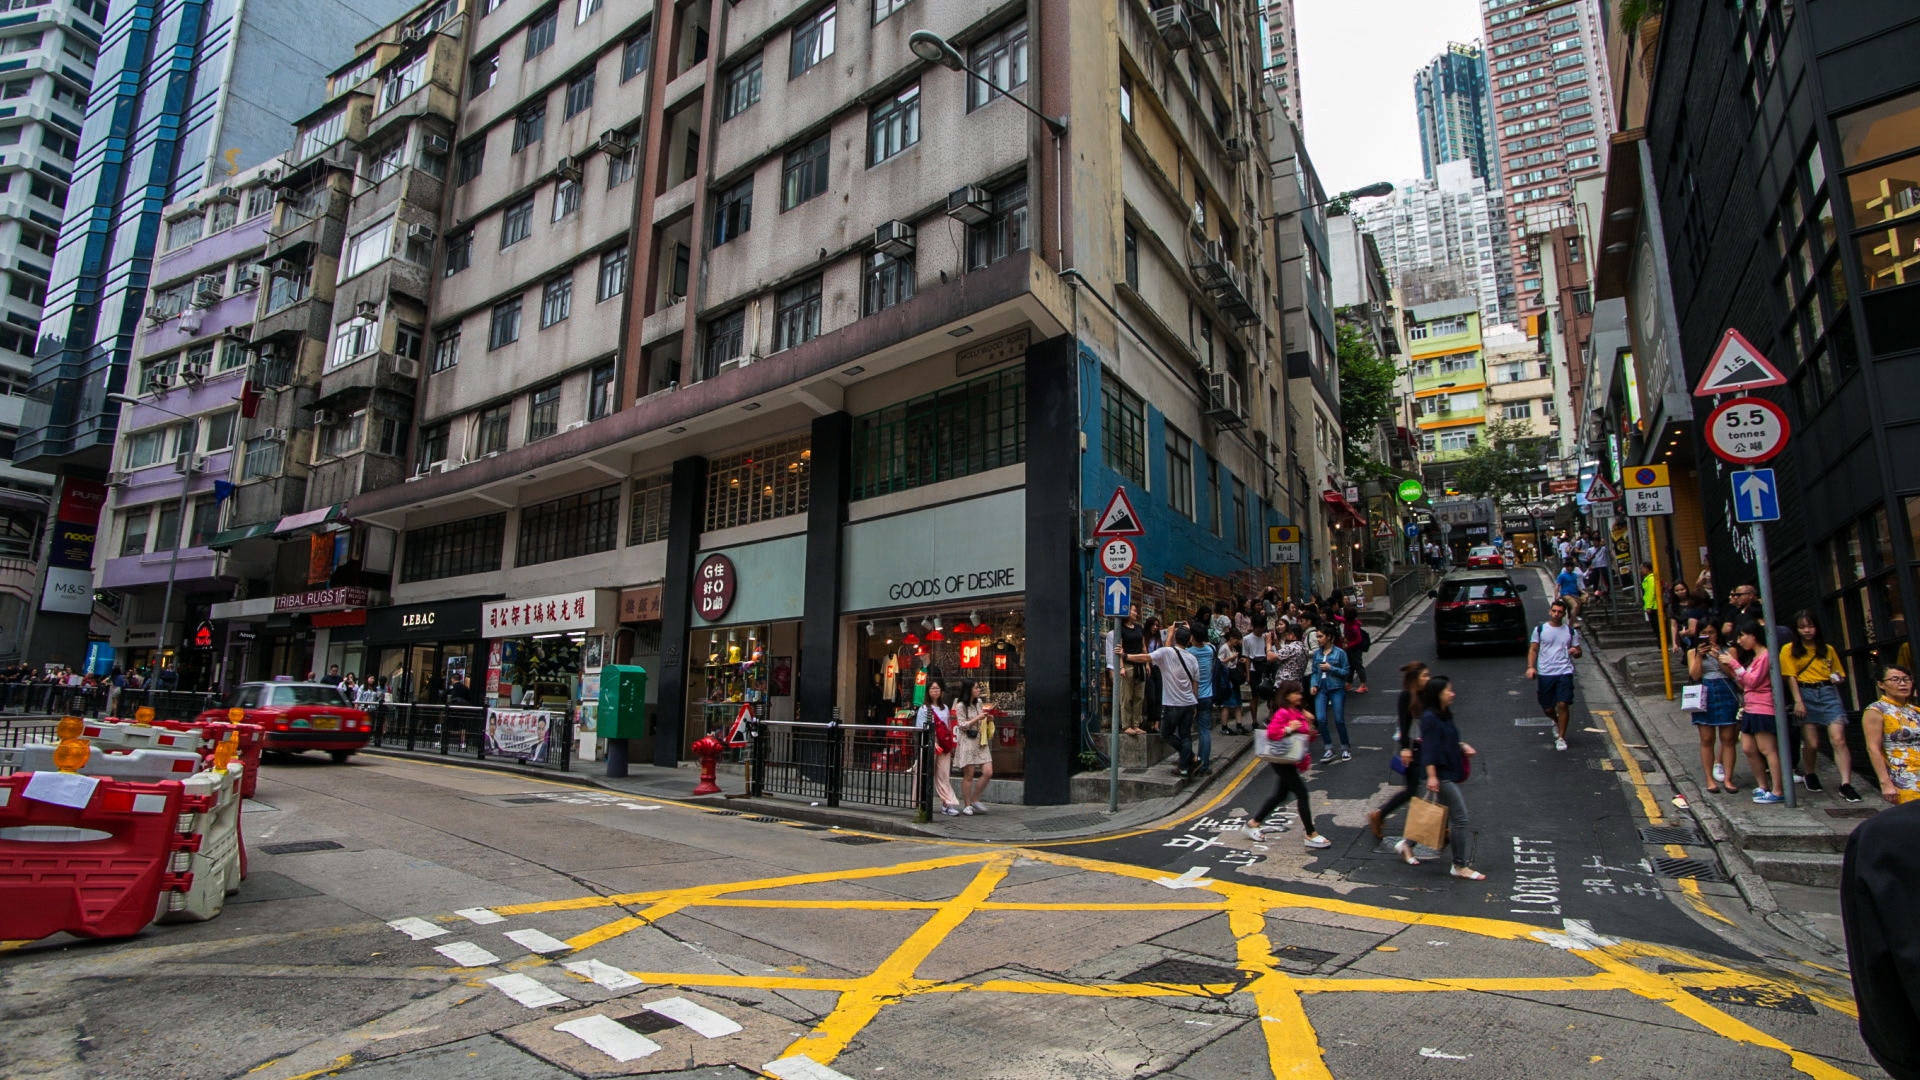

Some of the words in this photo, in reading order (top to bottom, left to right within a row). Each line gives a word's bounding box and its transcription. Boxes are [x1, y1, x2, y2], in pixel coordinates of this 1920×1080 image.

[1723, 355, 1747, 374] 1:5
[1725, 408, 1765, 428] 5.5
[1728, 430, 1766, 440] tonnes
[72, 489, 104, 502] PURE
[1638, 490, 1659, 500] End
[1634, 501, 1665, 513] 終止
[1110, 508, 1125, 522] 1:5
[1109, 544, 1127, 555] 5.5
[55, 583, 86, 595] M&S
[889, 578, 941, 601] GOODS
[944, 574, 965, 594] OF
[968, 567, 1015, 591] DESIRE
[347, 587, 367, 595] TRIBAL
[276, 595, 305, 609] TRIBAL
[307, 589, 333, 605] RUGS
[335, 588, 346, 604] 1/F
[402, 612, 436, 627] LEBAC
[239, 632, 256, 640] Aesop
[1513, 836, 1557, 873] LEFT
[1510, 876, 1561, 915] LOOK
